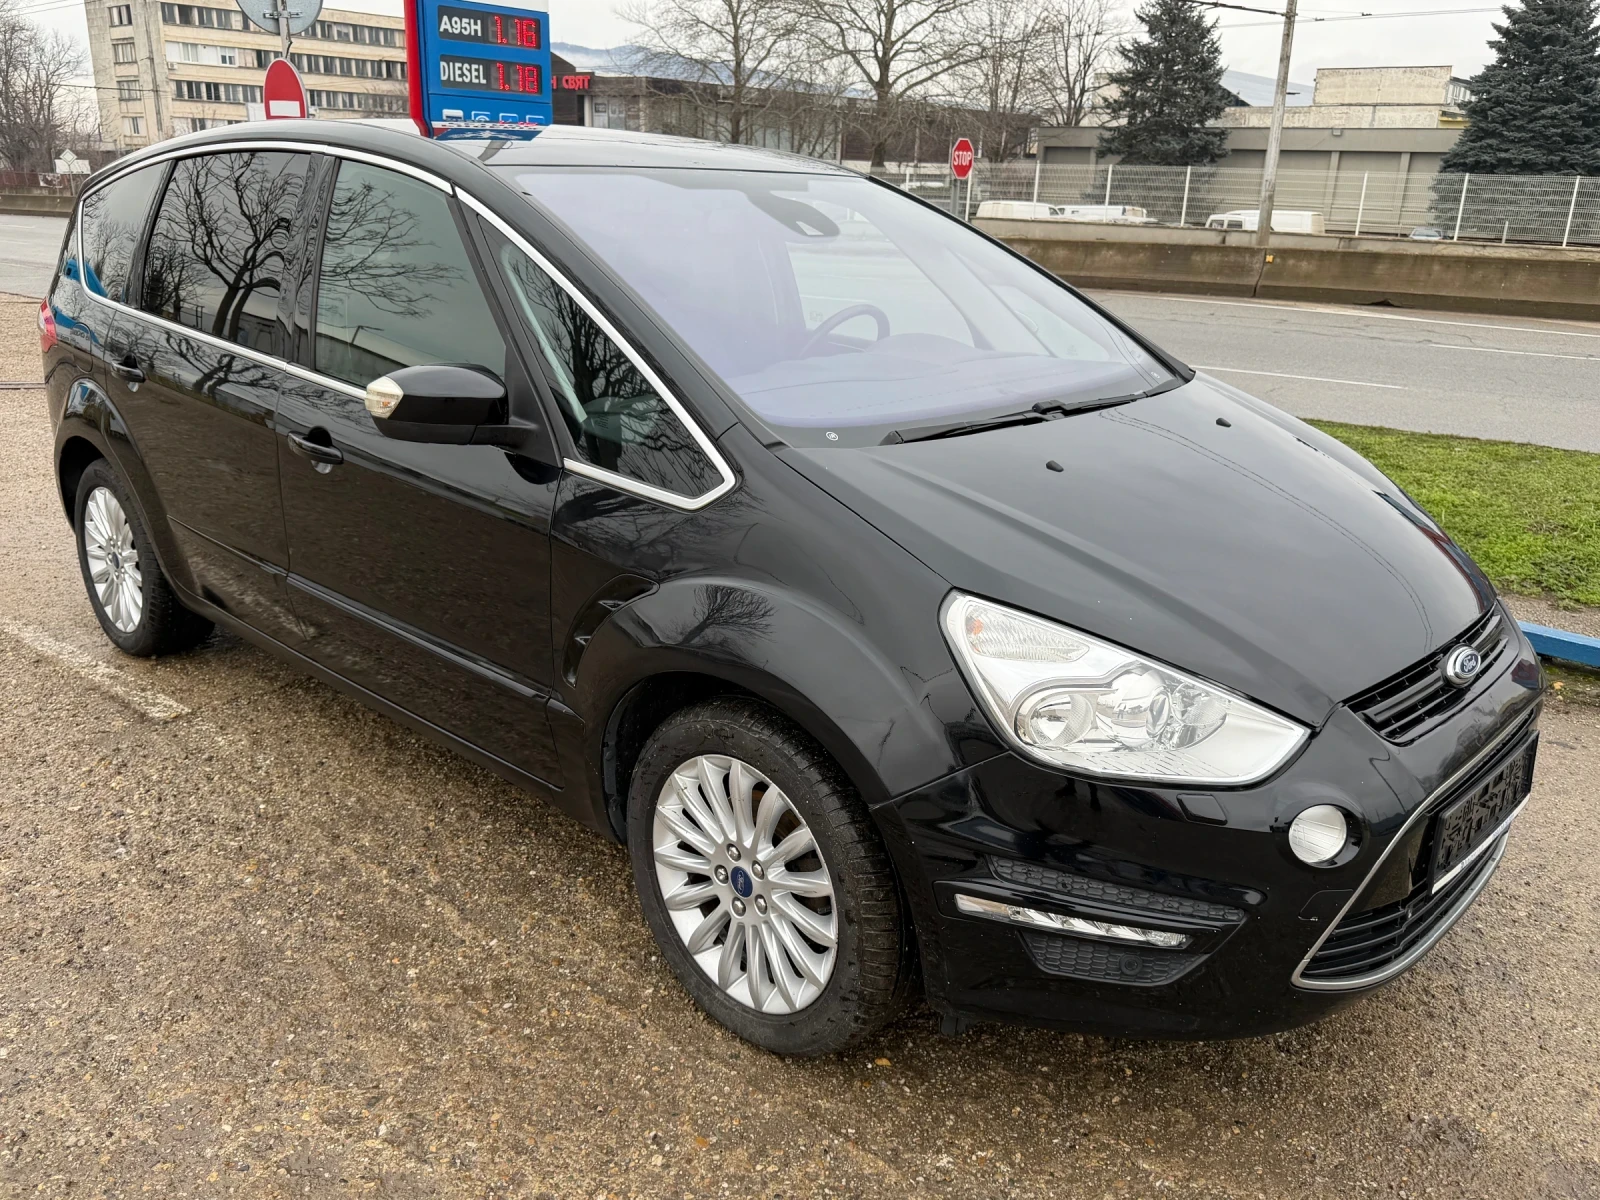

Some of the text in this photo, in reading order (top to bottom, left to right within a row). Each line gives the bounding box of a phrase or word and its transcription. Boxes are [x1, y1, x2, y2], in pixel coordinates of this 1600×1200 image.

[439, 15, 536, 48] A95H 1.16
[440, 61, 538, 93] DIESEL 1.18
[562, 75, 590, 90] СВЯТ
[953, 150, 972, 166] STOP
